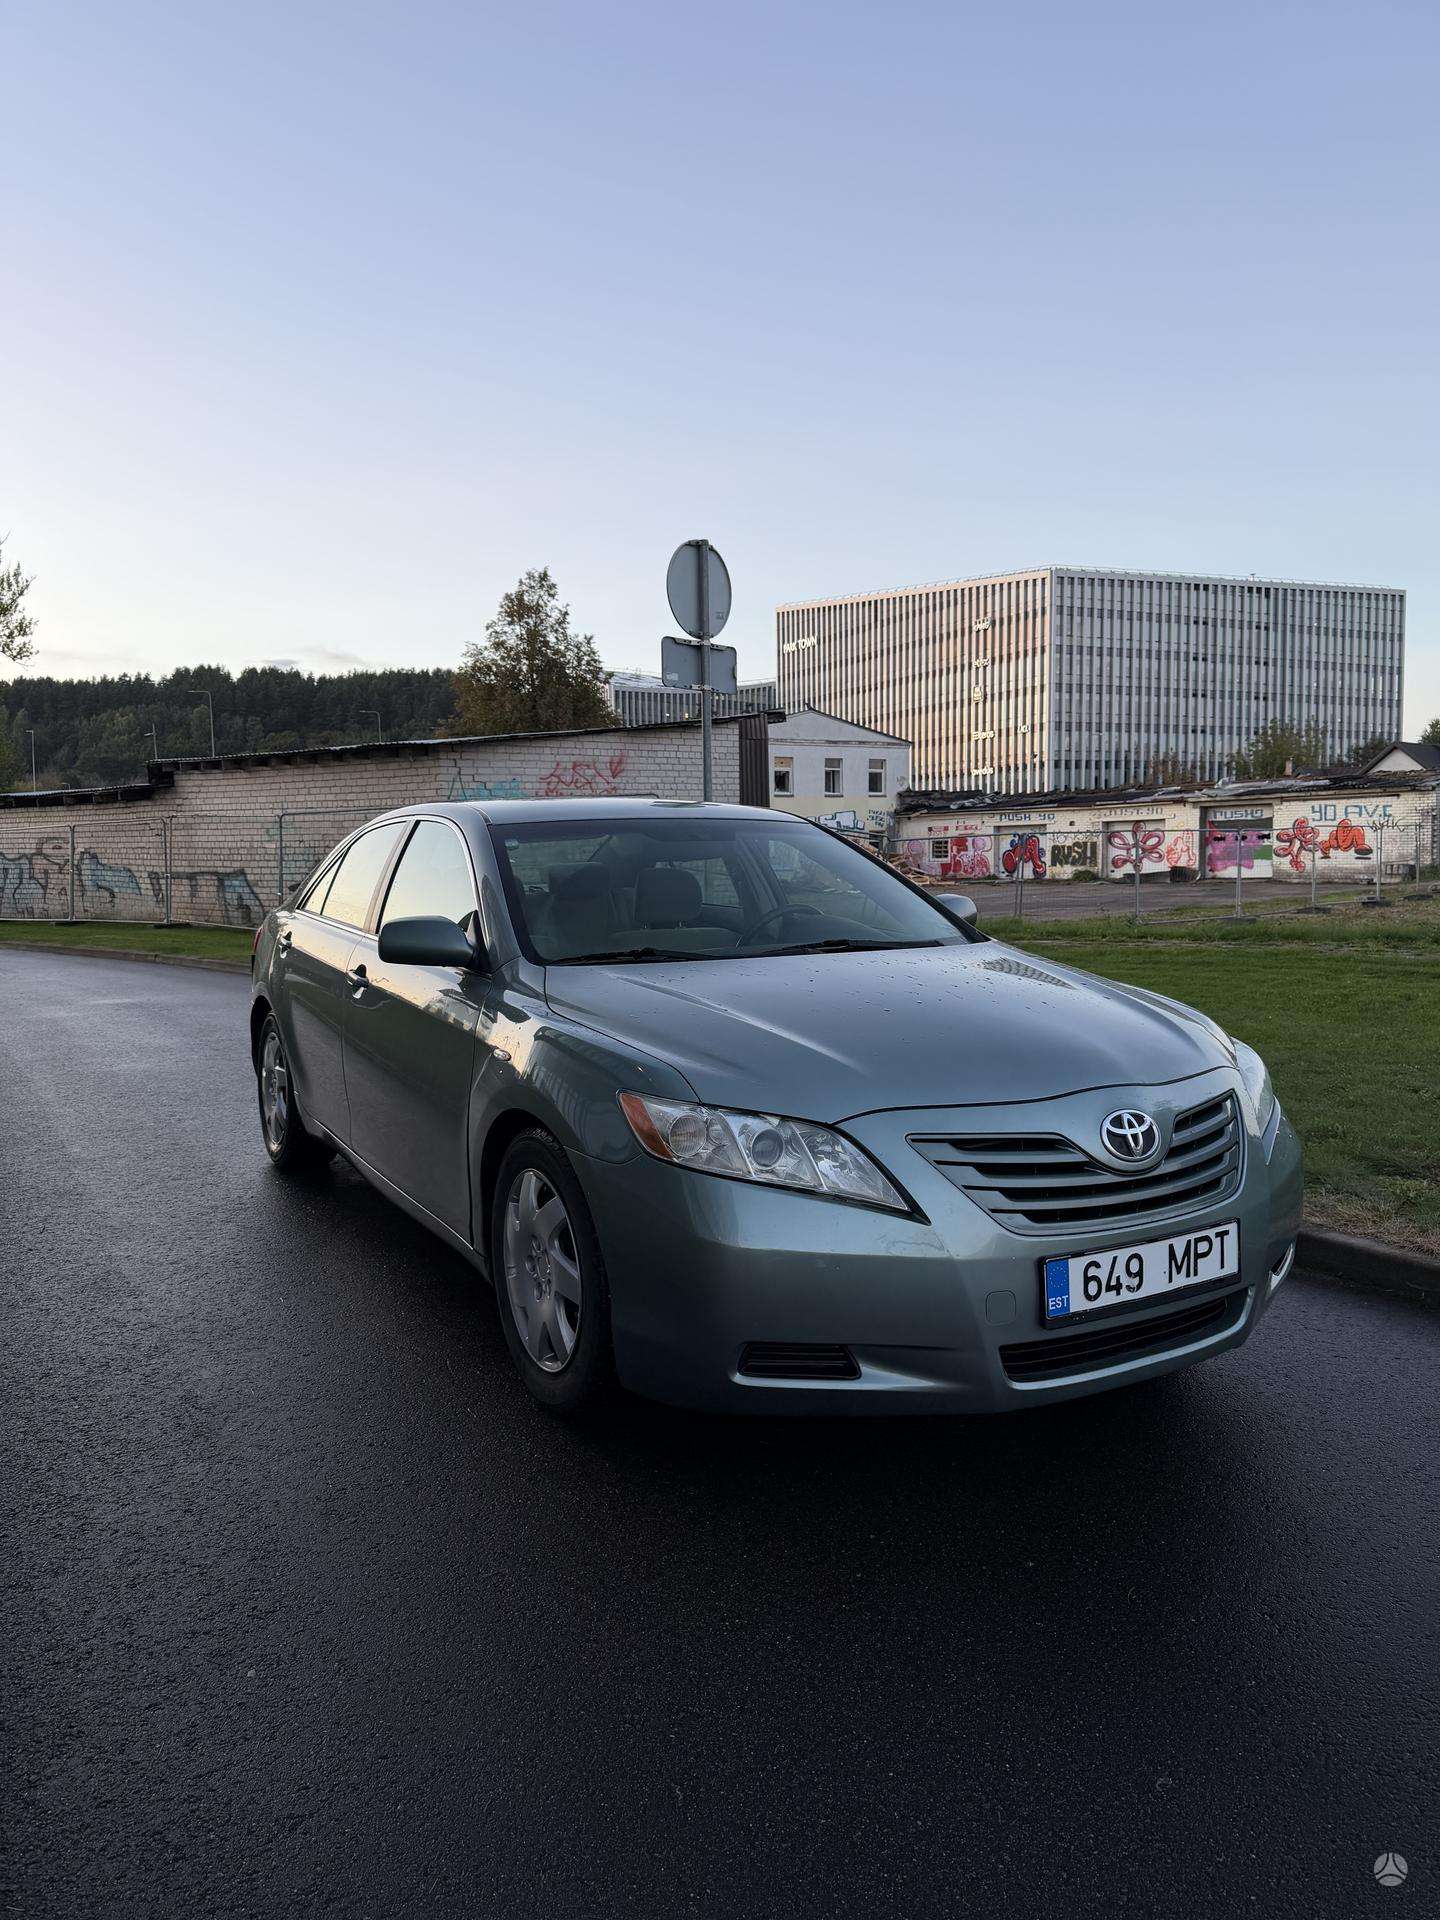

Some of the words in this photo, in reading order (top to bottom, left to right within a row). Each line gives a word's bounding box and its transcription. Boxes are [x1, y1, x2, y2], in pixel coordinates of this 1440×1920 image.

[797, 635, 817, 650] TOWN
[1083, 1252, 1144, 1302] 649
[1168, 1229, 1230, 1283] MPT
[1049, 1294, 1068, 1310] EST
